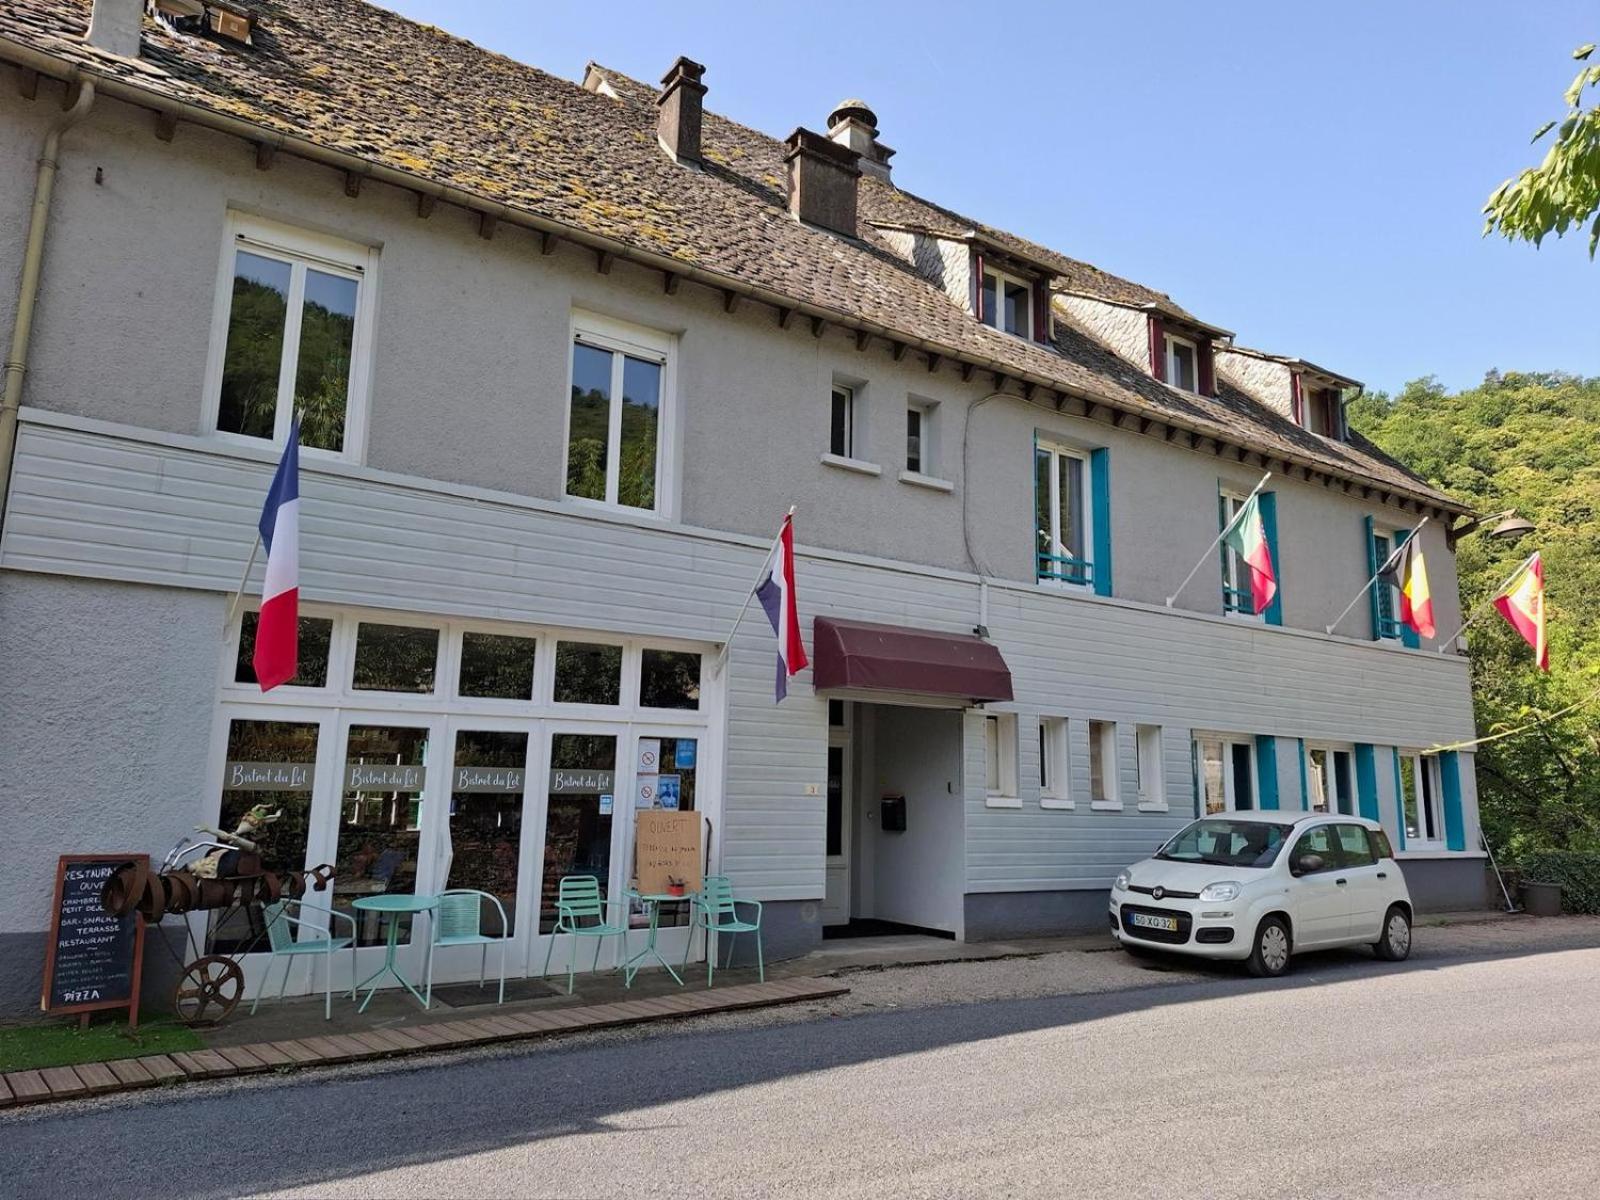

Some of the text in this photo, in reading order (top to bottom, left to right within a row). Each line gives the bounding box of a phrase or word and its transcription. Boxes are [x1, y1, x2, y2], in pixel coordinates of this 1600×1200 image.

[231, 765, 306, 787] Bistrot du Lot
[351, 767, 419, 788] Bistrot du Lot
[458, 770, 520, 789] Bistrot du Lot
[554, 772, 609, 791] Bistrot du Lot
[79, 881, 106, 891] OUVE
[76, 924, 120, 935] TERRASSE
[59, 936, 115, 948] RESTAURANT
